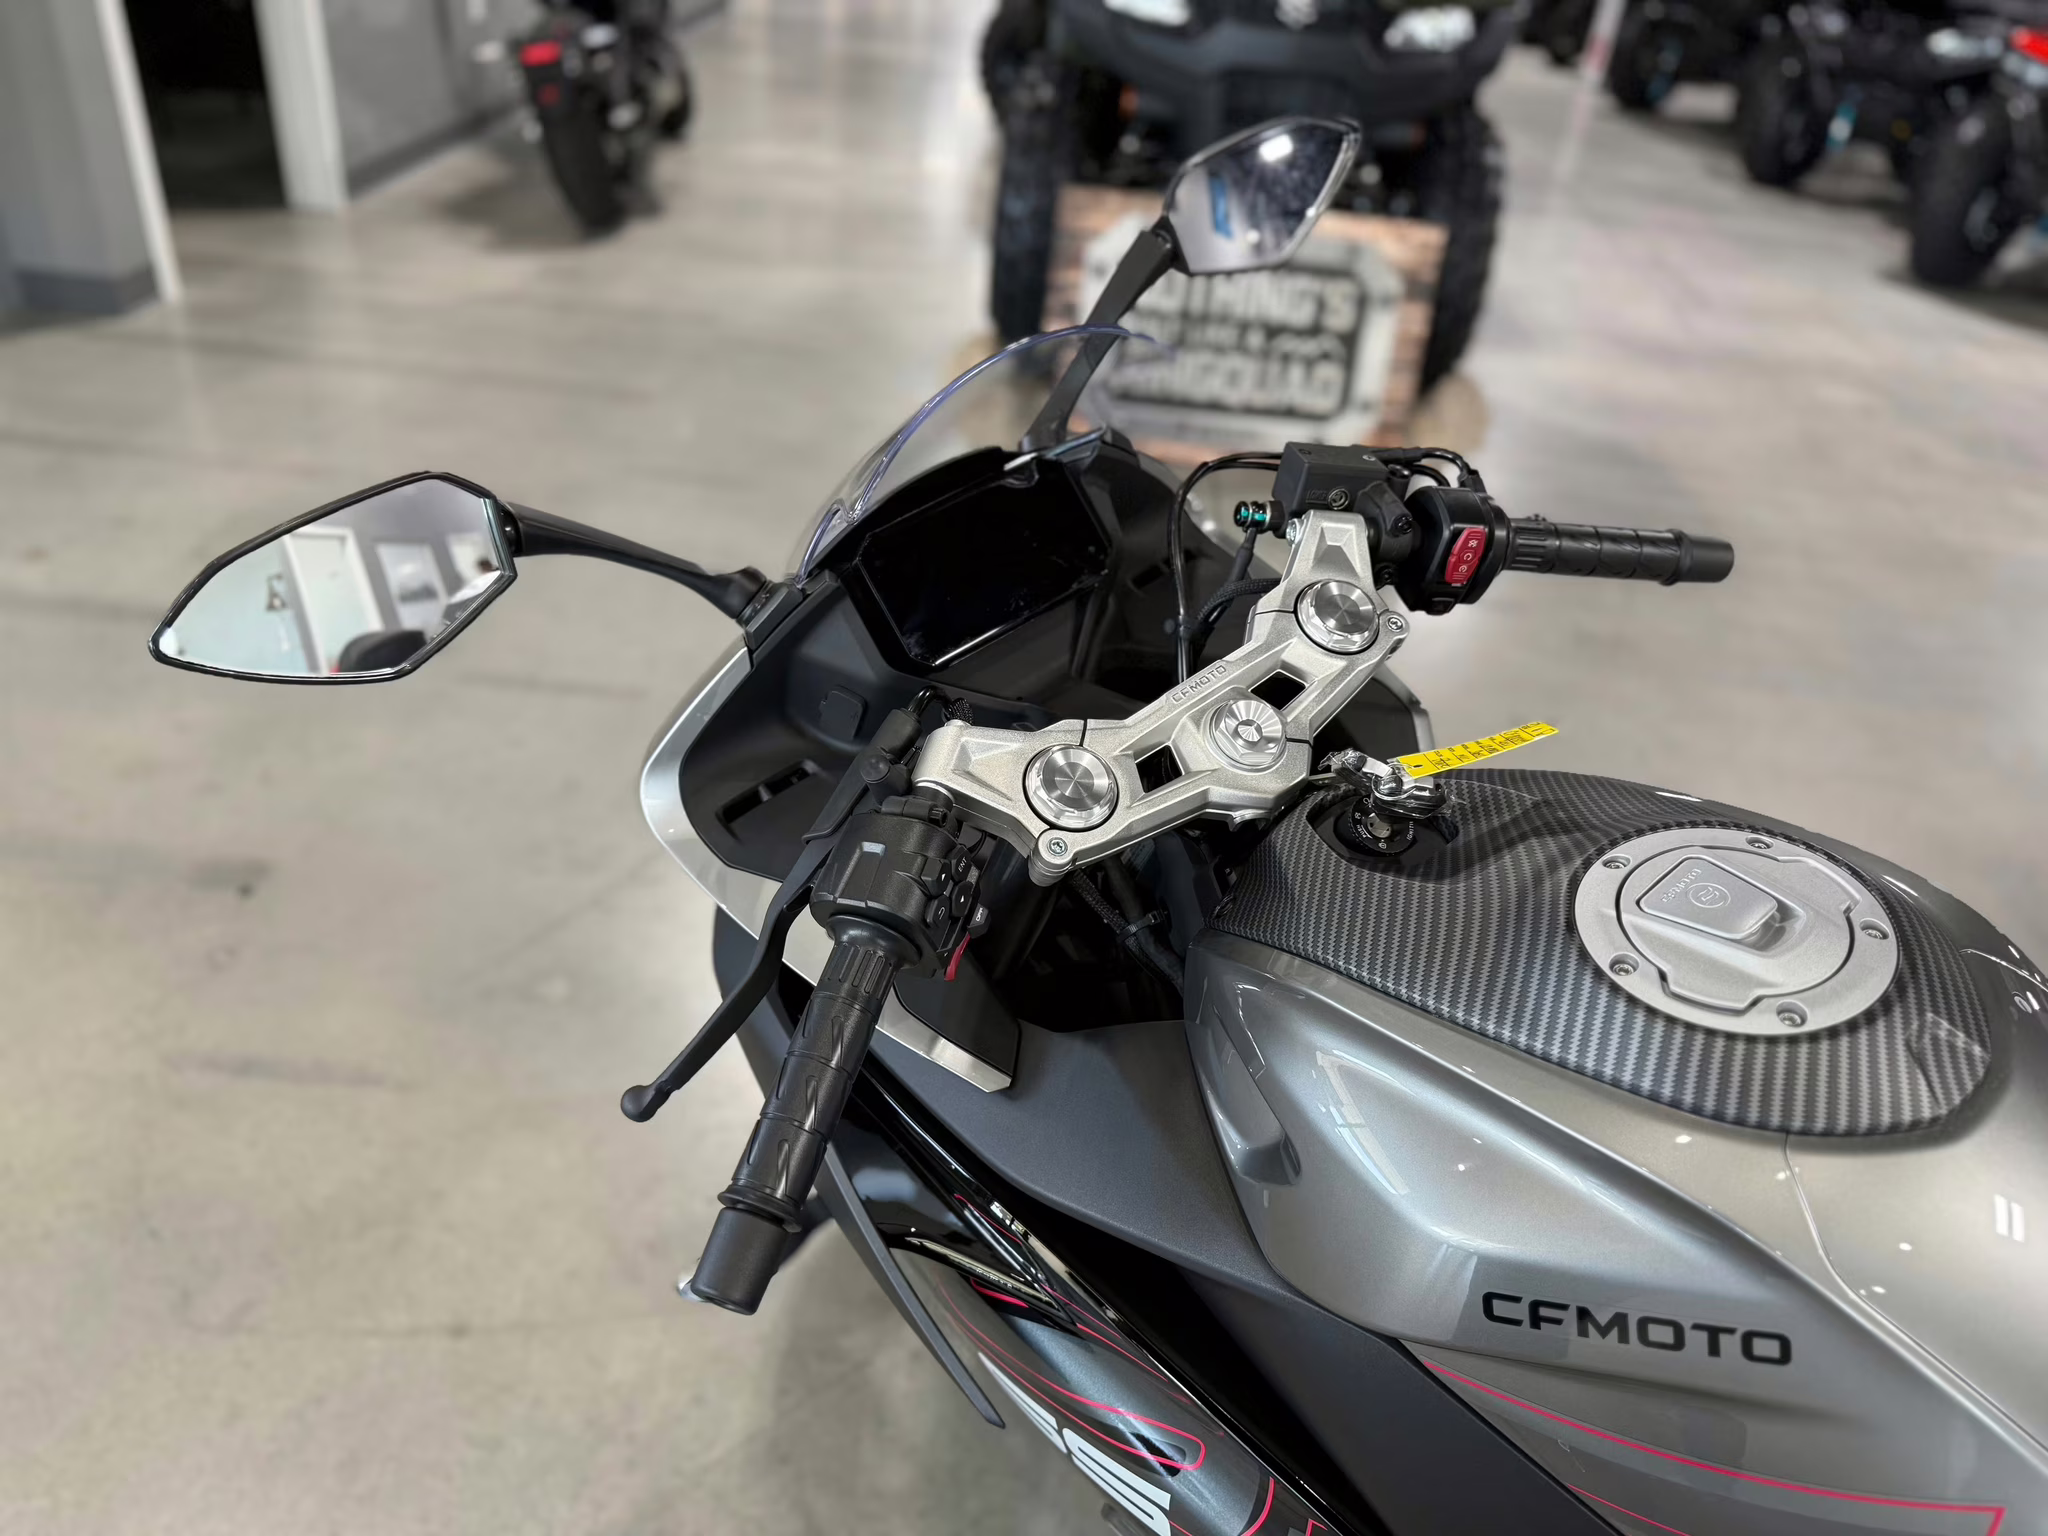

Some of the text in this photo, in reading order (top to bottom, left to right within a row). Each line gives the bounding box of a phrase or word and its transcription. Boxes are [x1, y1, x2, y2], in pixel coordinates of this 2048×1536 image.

[1171, 665, 1226, 703] CFMOTO
[958, 857, 967, 873] ENT
[1481, 1291, 1793, 1367] CFMOTO
